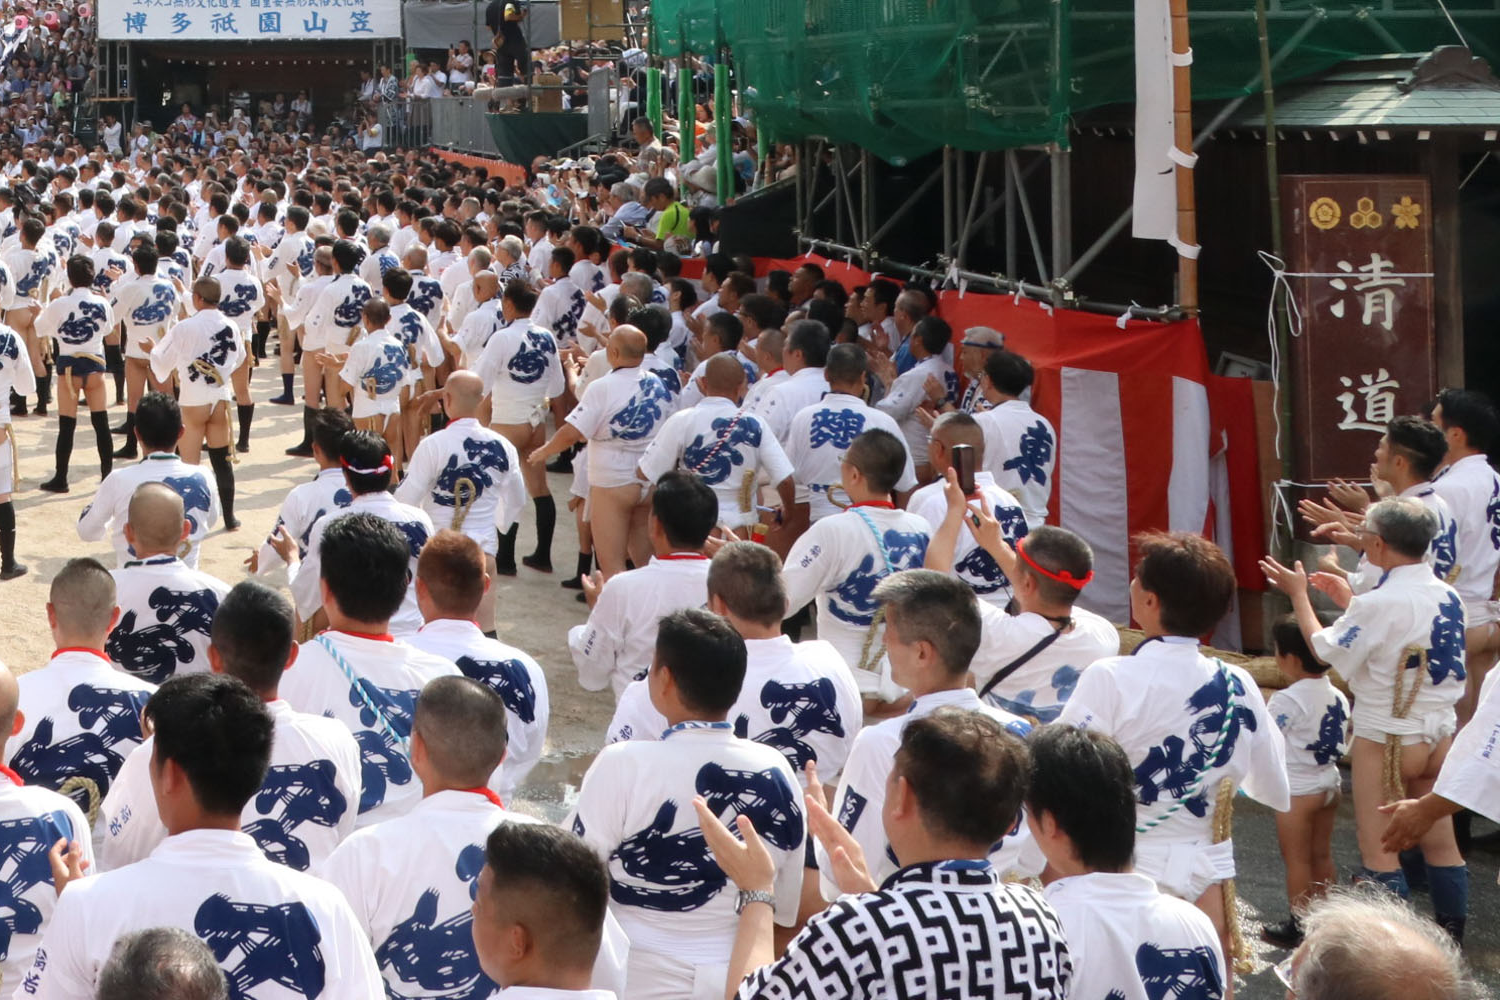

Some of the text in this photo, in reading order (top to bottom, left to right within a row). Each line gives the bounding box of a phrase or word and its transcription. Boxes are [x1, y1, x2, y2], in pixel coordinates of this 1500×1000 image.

[122, 10, 375, 35] 博多祇園山笠
[1328, 252, 1406, 434] 清道
